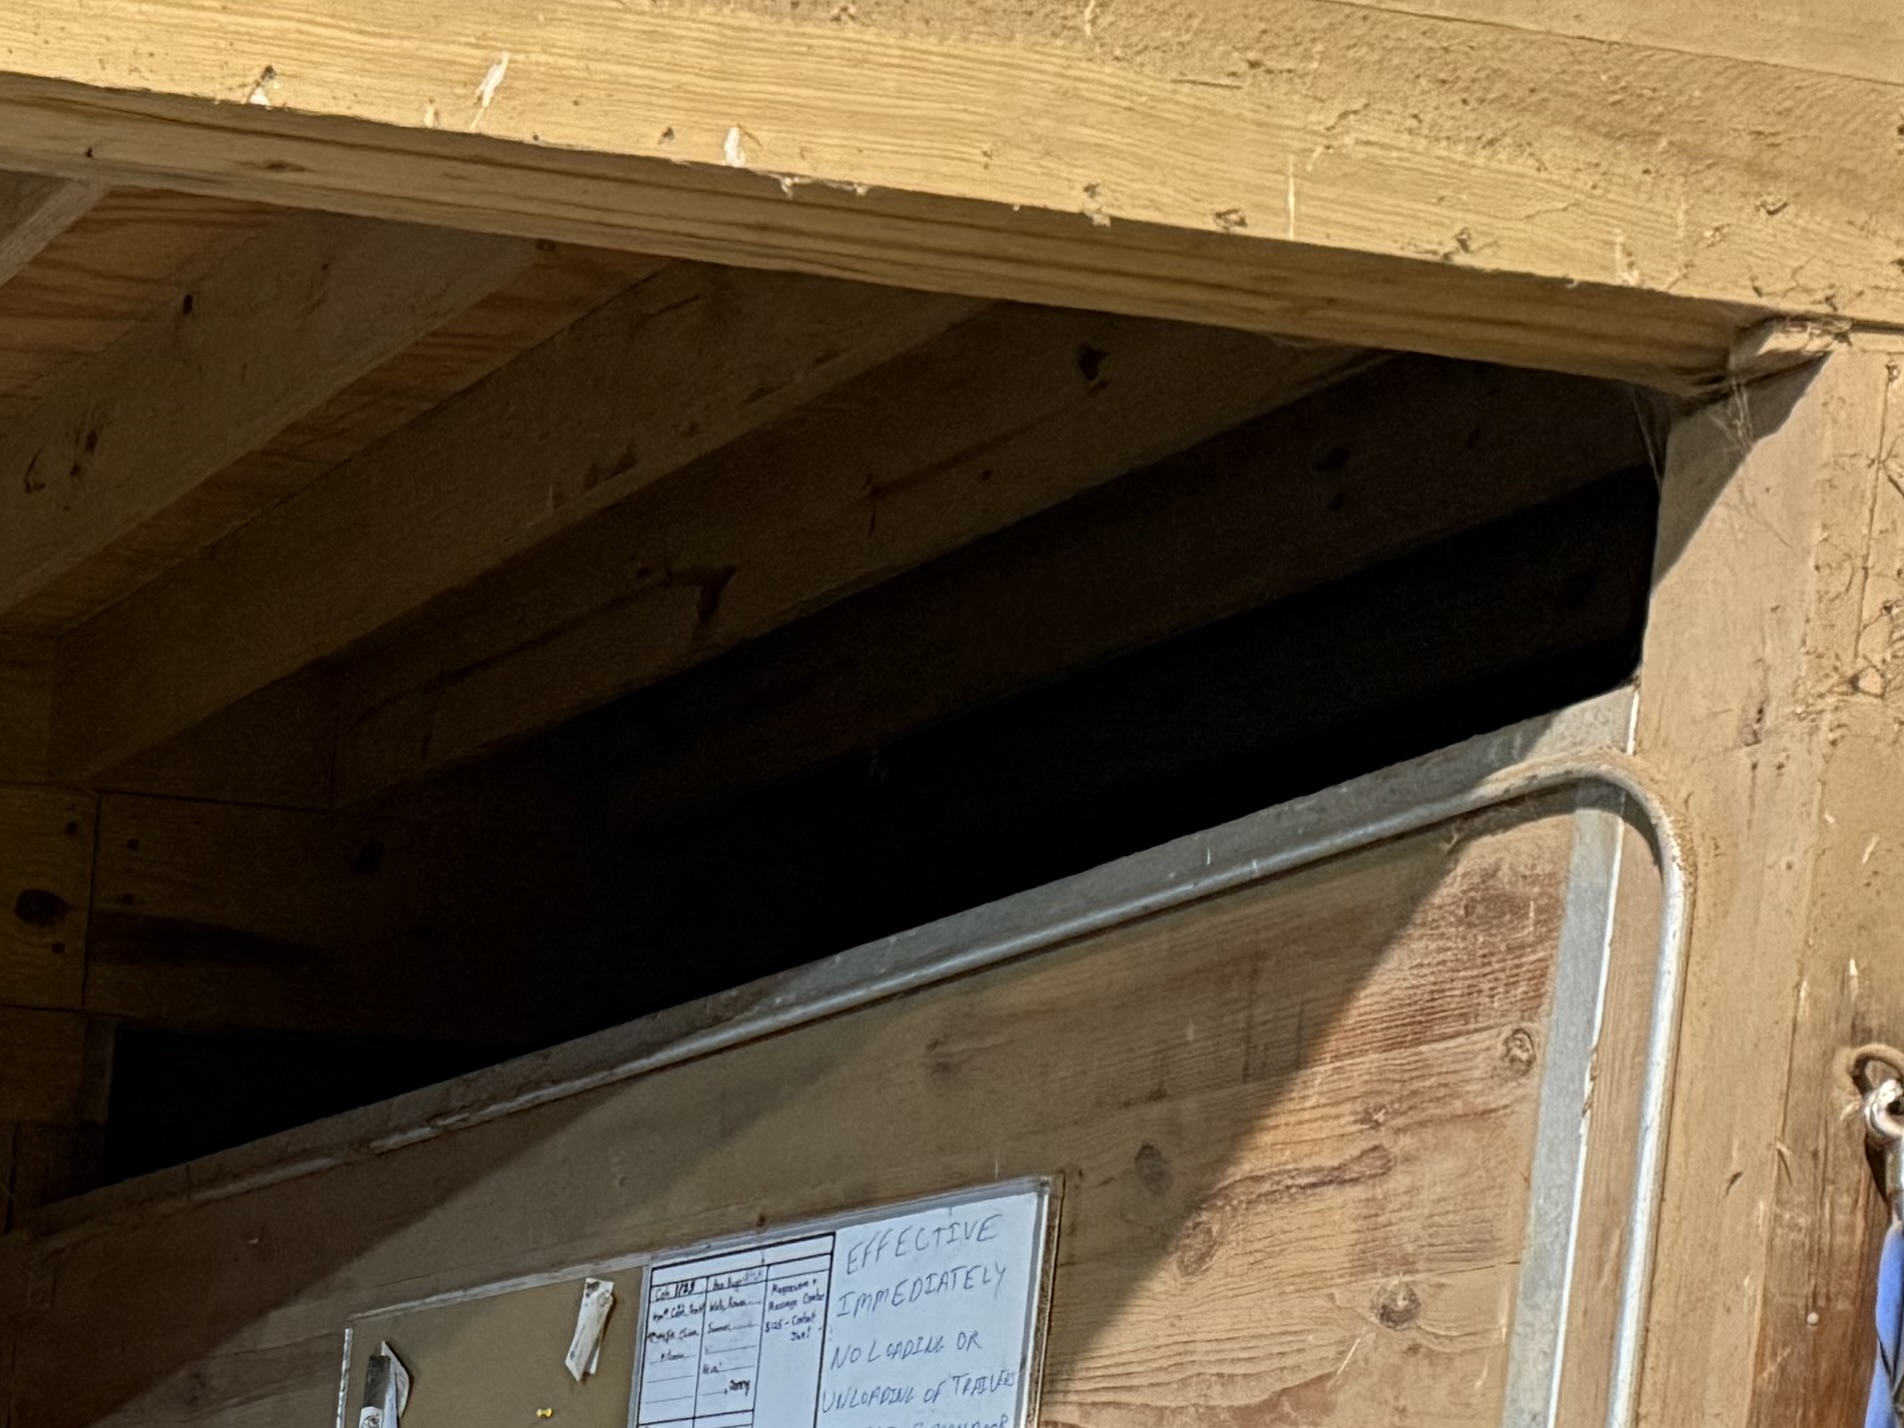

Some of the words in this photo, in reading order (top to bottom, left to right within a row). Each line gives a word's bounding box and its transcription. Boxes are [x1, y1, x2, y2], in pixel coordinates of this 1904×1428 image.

[847, 1214, 1002, 1275] EFFECTIVE
[837, 1261, 1005, 1318] IMMEDIATELY
[831, 1345, 860, 1370] NO
[957, 1330, 982, 1351] OR
